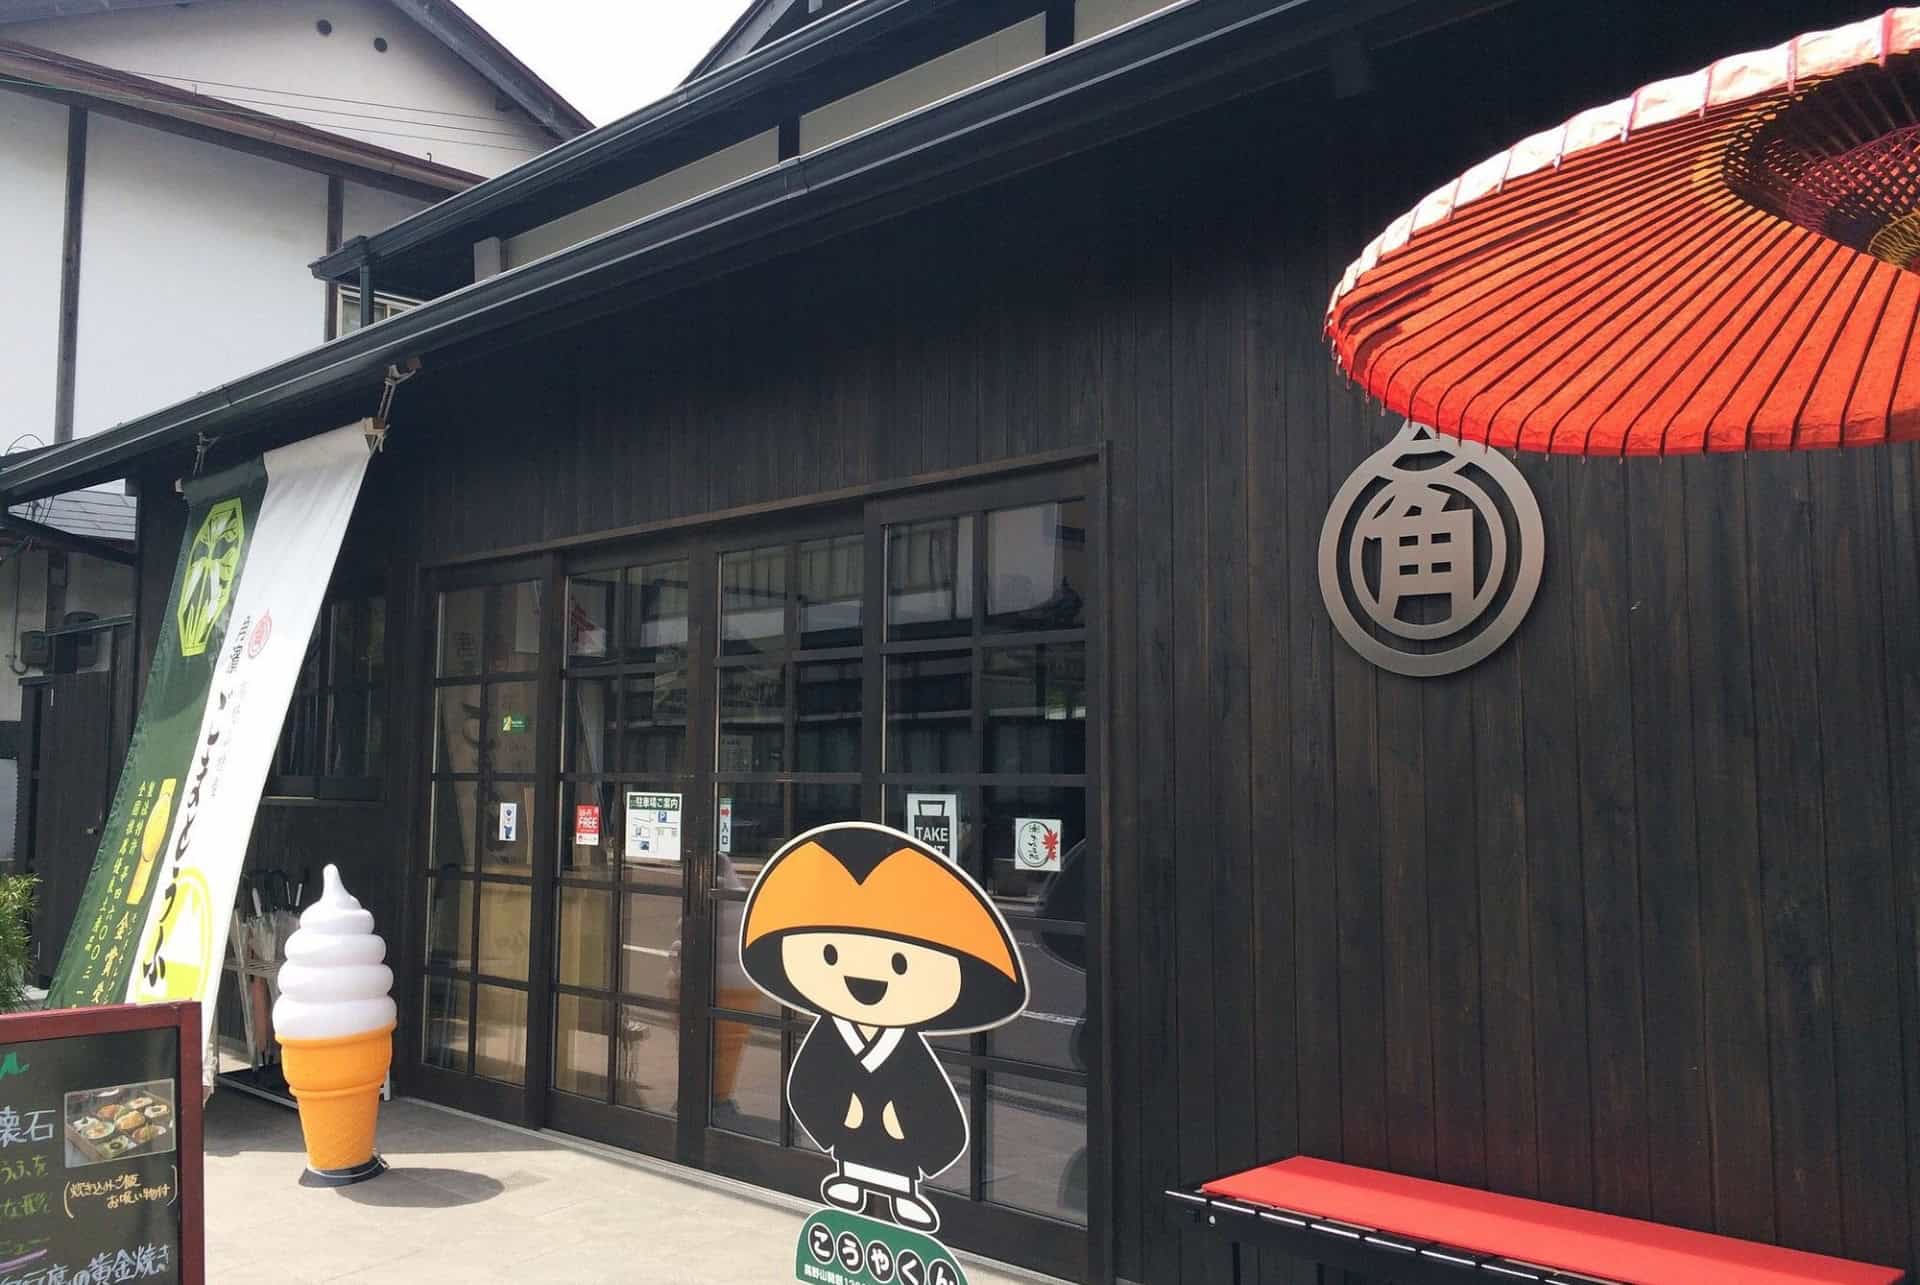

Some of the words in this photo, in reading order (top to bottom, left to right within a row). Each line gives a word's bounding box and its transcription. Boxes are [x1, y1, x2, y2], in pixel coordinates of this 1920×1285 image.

[915, 826, 949, 842] TAKE
[812, 1230, 956, 1285] こうやくん
